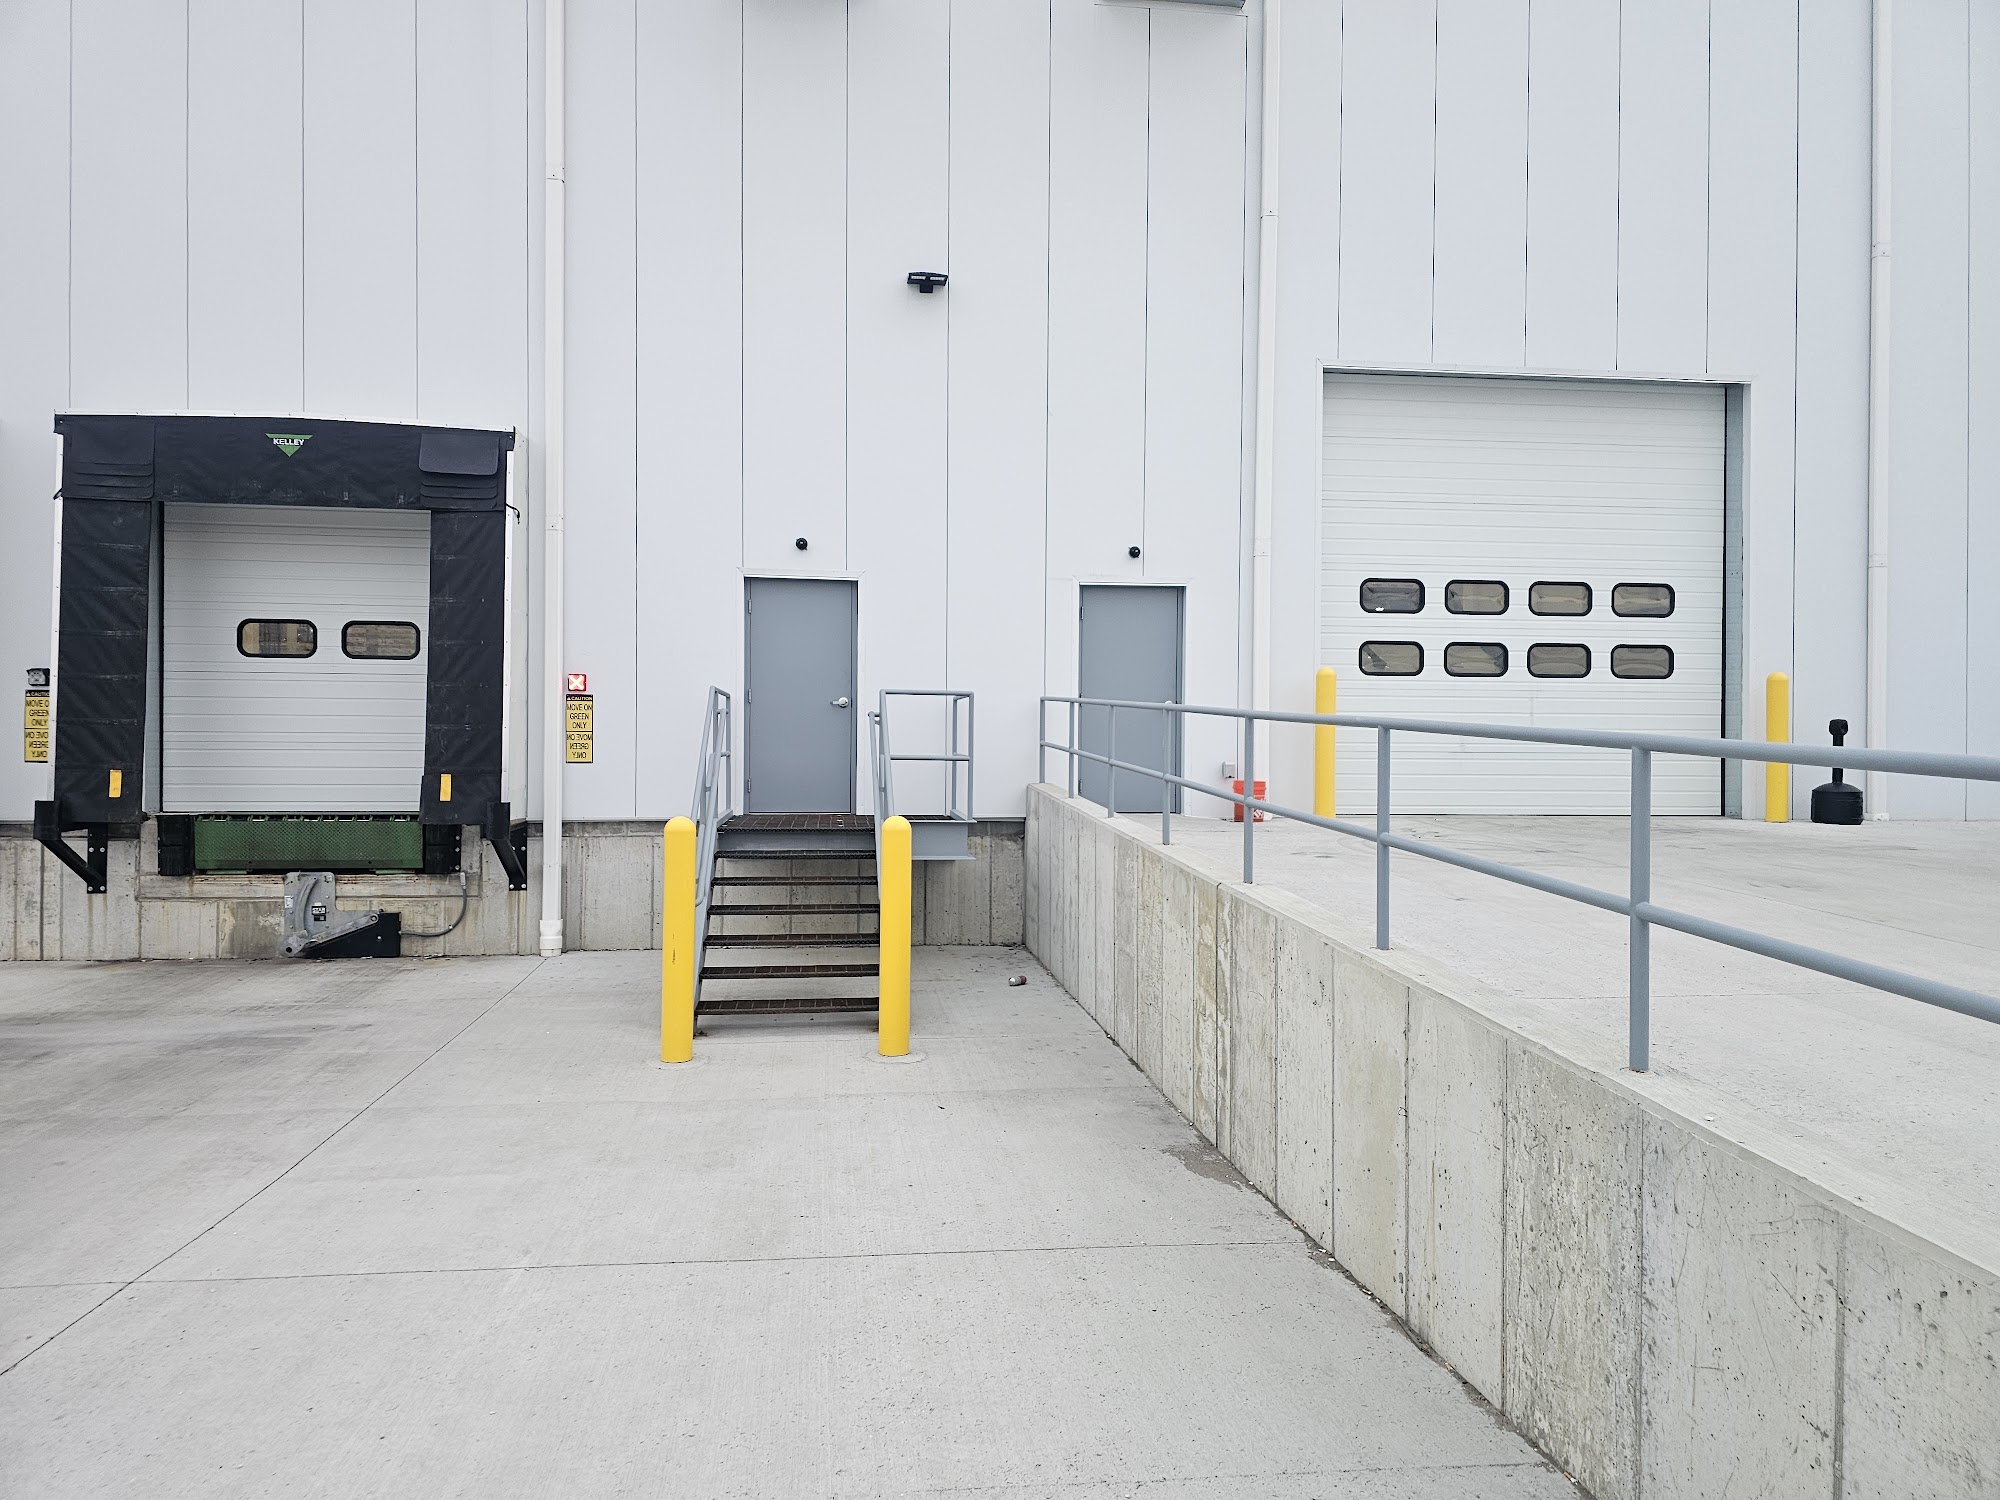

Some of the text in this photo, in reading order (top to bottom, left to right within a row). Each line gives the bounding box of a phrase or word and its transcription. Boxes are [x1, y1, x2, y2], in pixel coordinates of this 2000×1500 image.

[273, 438, 304, 446] KELLEY
[25, 699, 43, 707] MOVE
[566, 703, 592, 711] MOVE ON
[569, 712, 589, 720] GREEN
[31, 718, 48, 726] ONLY
[572, 721, 587, 729] ONLY
